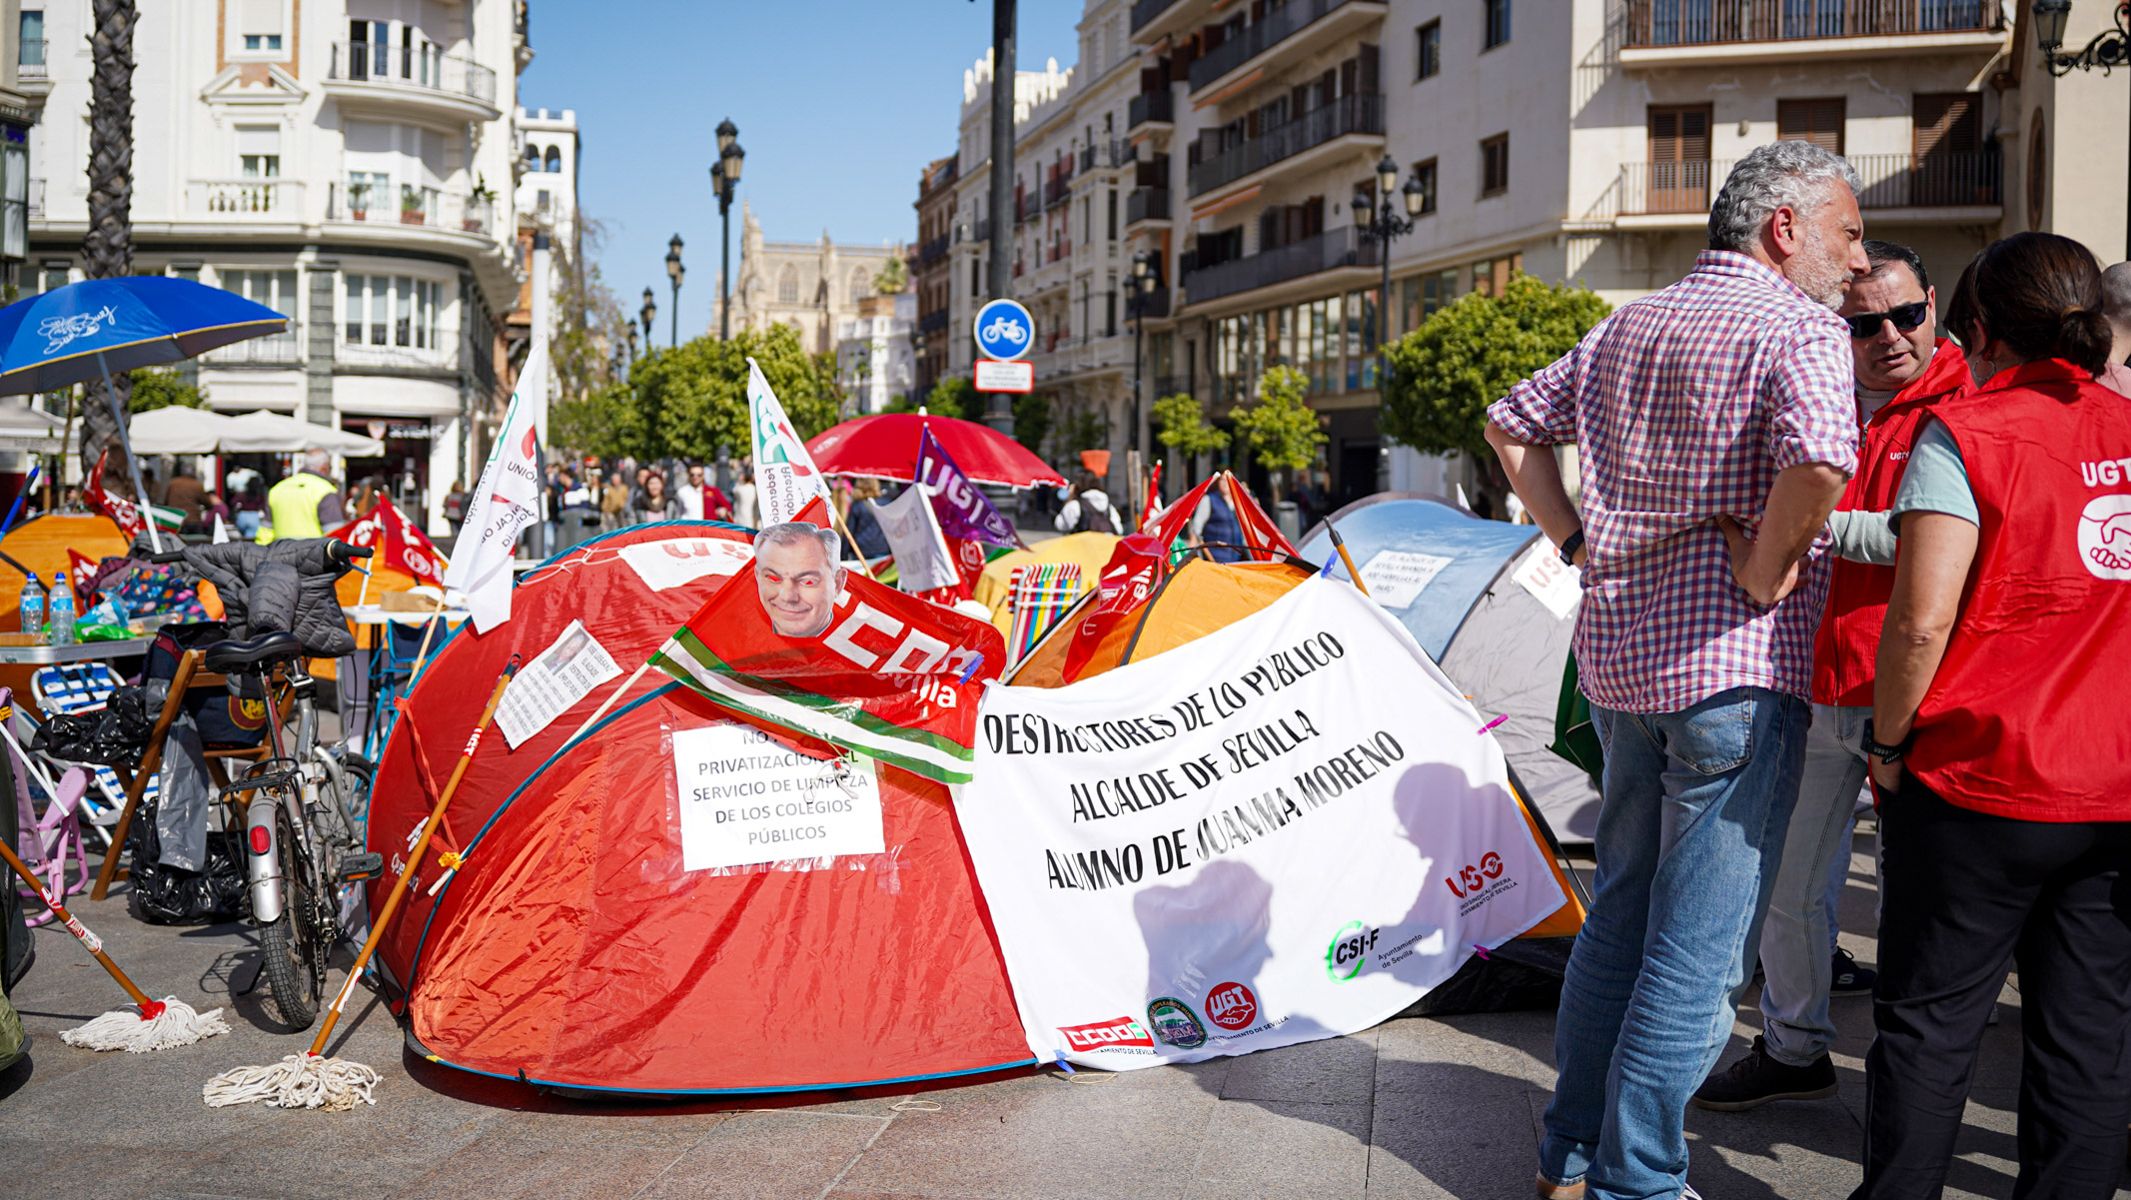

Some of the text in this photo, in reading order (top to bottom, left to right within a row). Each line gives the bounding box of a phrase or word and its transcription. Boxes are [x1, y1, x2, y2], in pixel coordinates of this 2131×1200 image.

[1171, 692, 1213, 732] DE
[1208, 681, 1247, 719] LO
[1069, 708, 1320, 824] ALCALDE DE SEVILLA
[692, 781, 767, 802] SERVICIO
[771, 778, 792, 793] DE
[715, 799, 853, 825] DE LOS COLEGIOS
[1046, 730, 1405, 892] ALUMNO DE JUANMA MORENO
[748, 825, 827, 846] PÚBLICOS
[1445, 851, 1504, 899] USO
[1377, 934, 1423, 962] Ayuntamiento
[1381, 949, 1414, 969] de Sevilla
[1210, 986, 1245, 1013] UGT
[1264, 1015, 1290, 1031] SEVILLA
